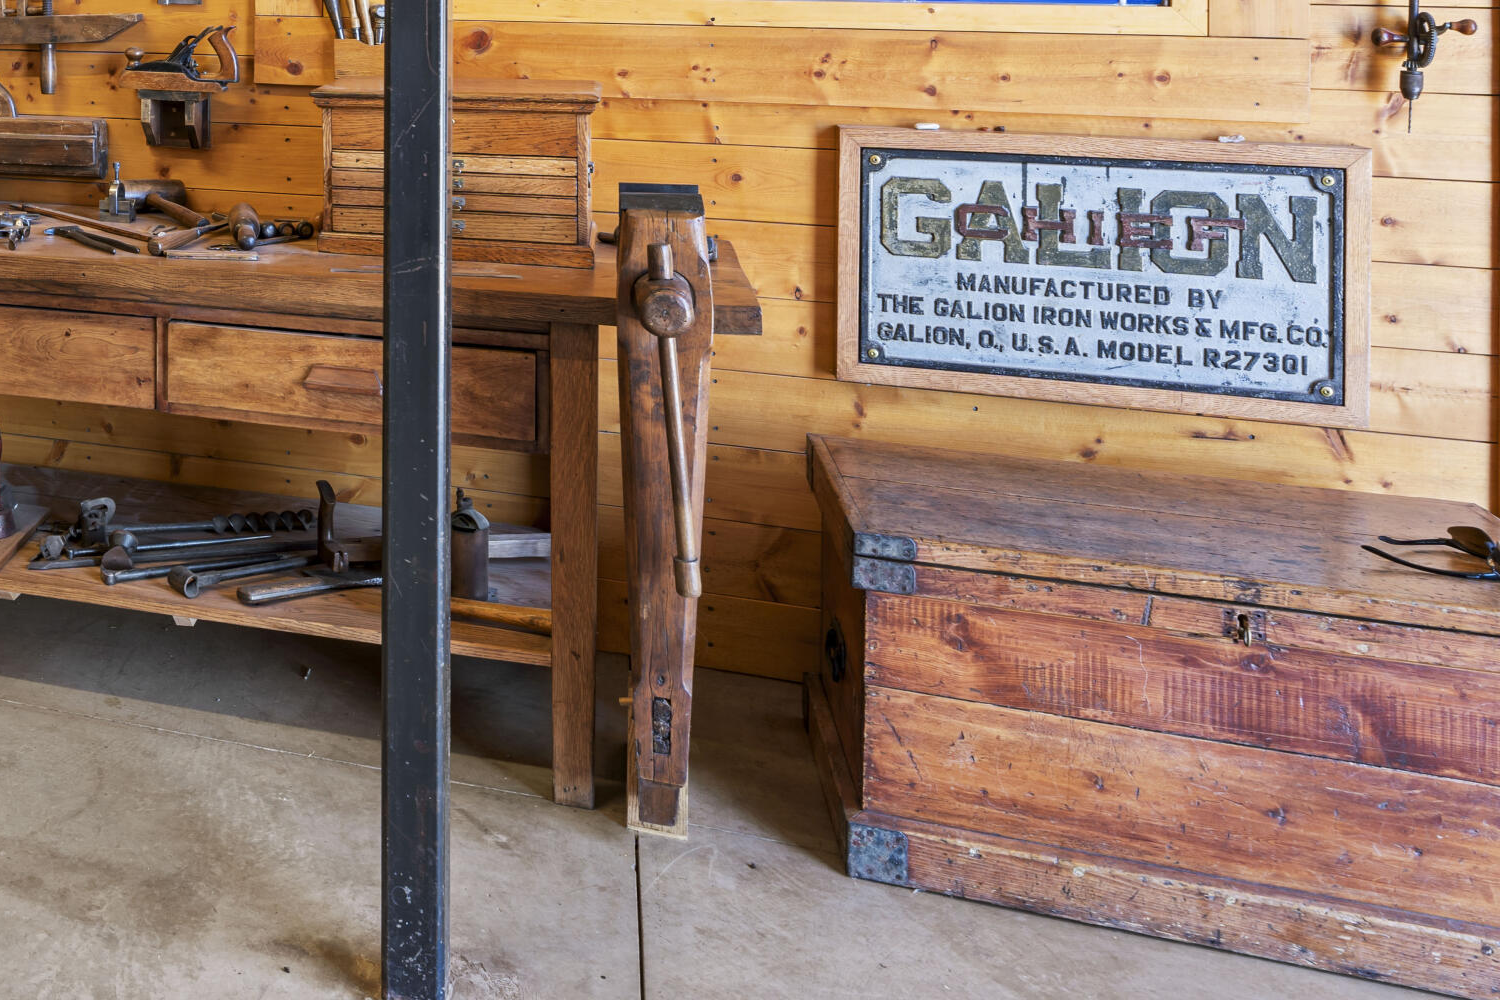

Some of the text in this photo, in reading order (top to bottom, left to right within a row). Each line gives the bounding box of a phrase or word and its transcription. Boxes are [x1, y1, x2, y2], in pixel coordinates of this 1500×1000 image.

[880, 176, 1318, 284] GALION
[956, 203, 1246, 251] CHIEF
[956, 272, 1224, 309] MANUFACTURED BY
[876, 293, 924, 315] THE
[934, 297, 1026, 323] GALION
[1033, 305, 1092, 328] IRON
[1100, 311, 1189, 336] WORKS
[1195, 317, 1212, 337] &
[877, 322, 971, 349] GALION,
[1097, 340, 1193, 366] MODEL
[1203, 347, 1308, 376] R27301
